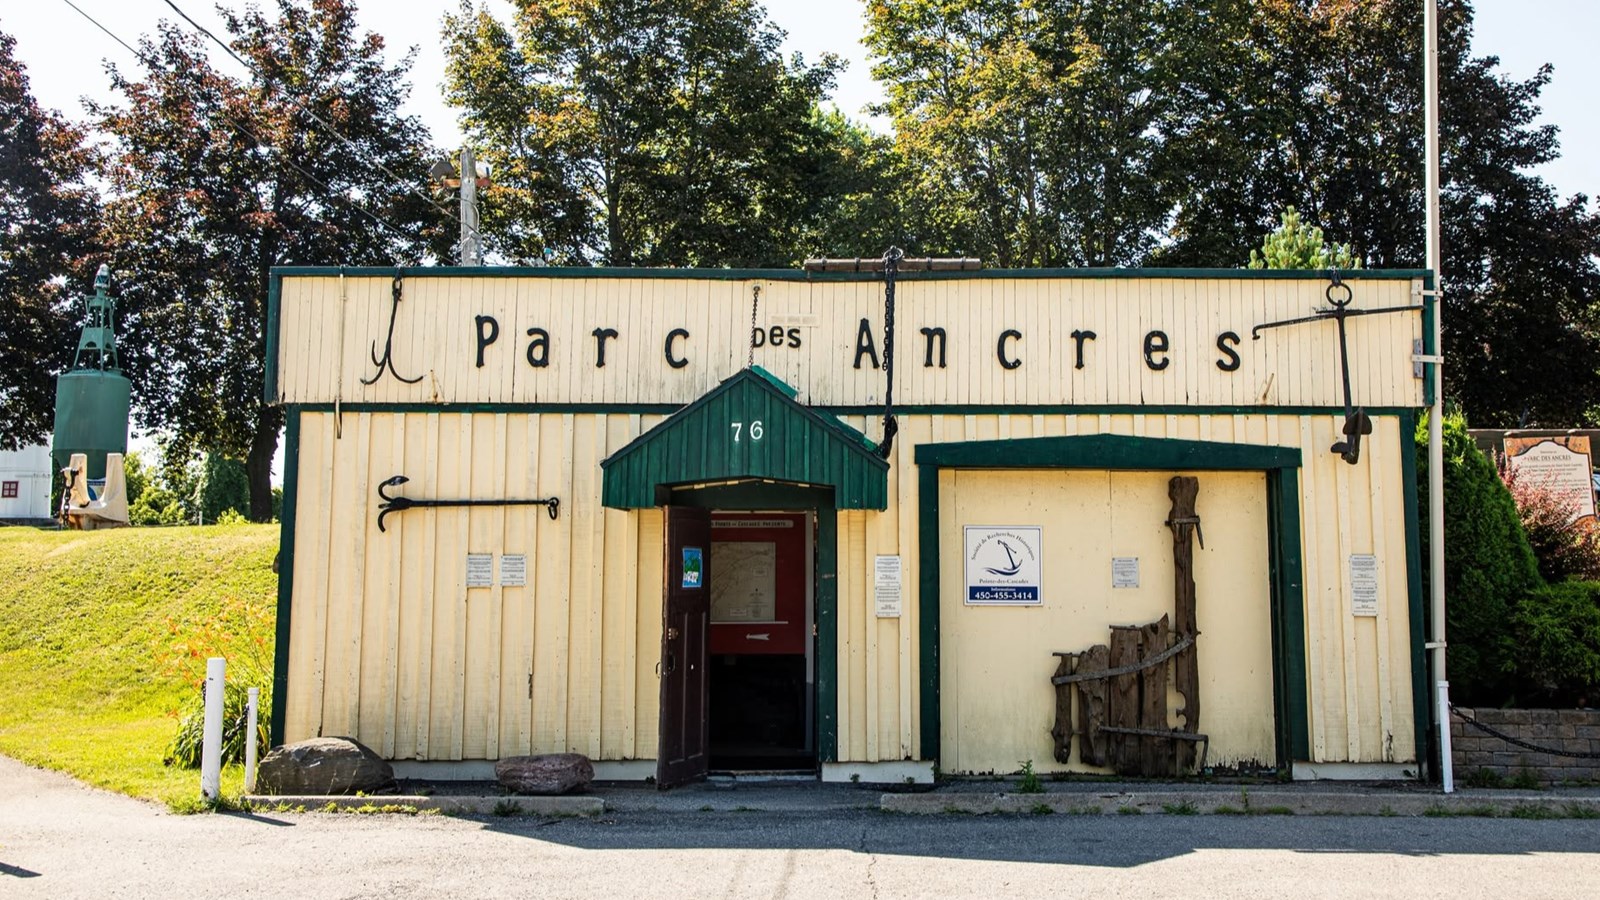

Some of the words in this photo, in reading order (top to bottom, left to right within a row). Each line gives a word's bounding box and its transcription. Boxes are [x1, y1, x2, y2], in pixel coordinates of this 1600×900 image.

[474, 314, 690, 369] Parc
[852, 317, 1241, 372] Ancres
[730, 420, 764, 442] 76
